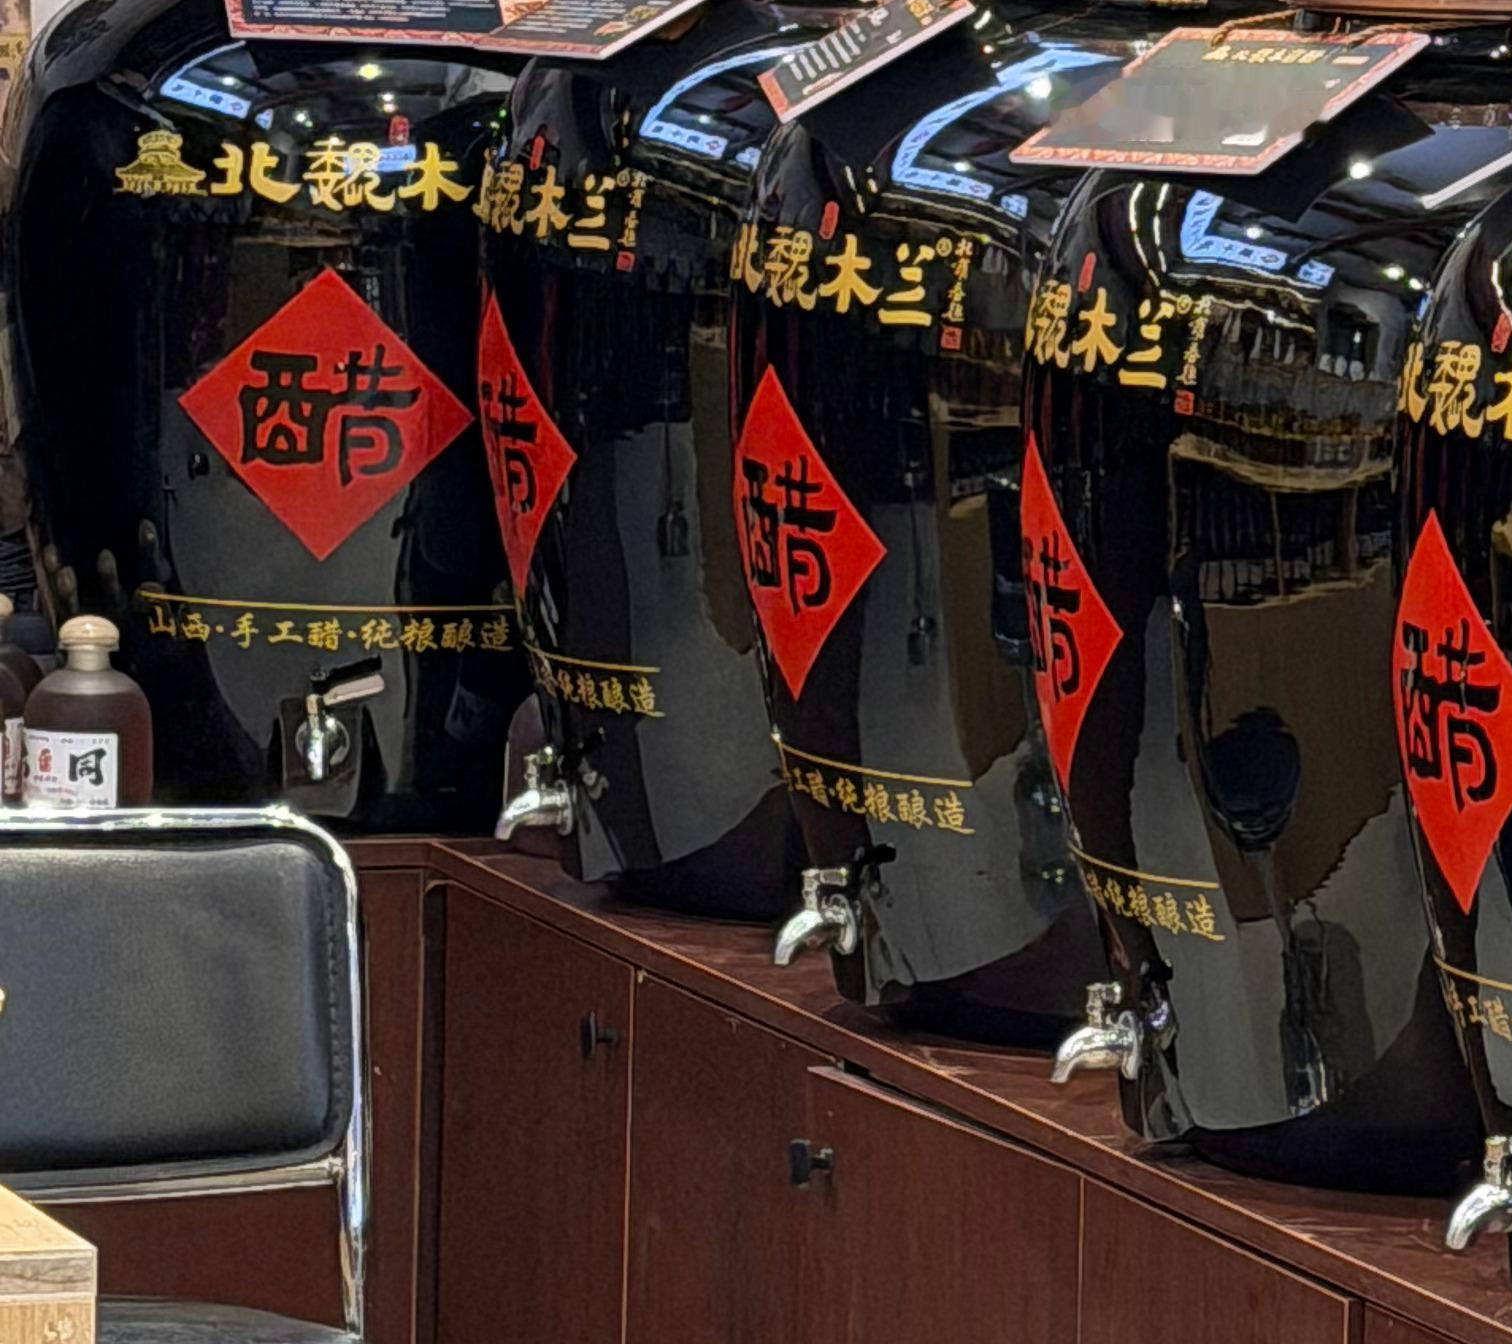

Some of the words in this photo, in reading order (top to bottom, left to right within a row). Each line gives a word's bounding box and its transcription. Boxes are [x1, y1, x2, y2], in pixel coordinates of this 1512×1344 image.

[240, 343, 425, 488] 醋
[741, 453, 838, 616] 醋
[1401, 617, 1501, 813] 醋
